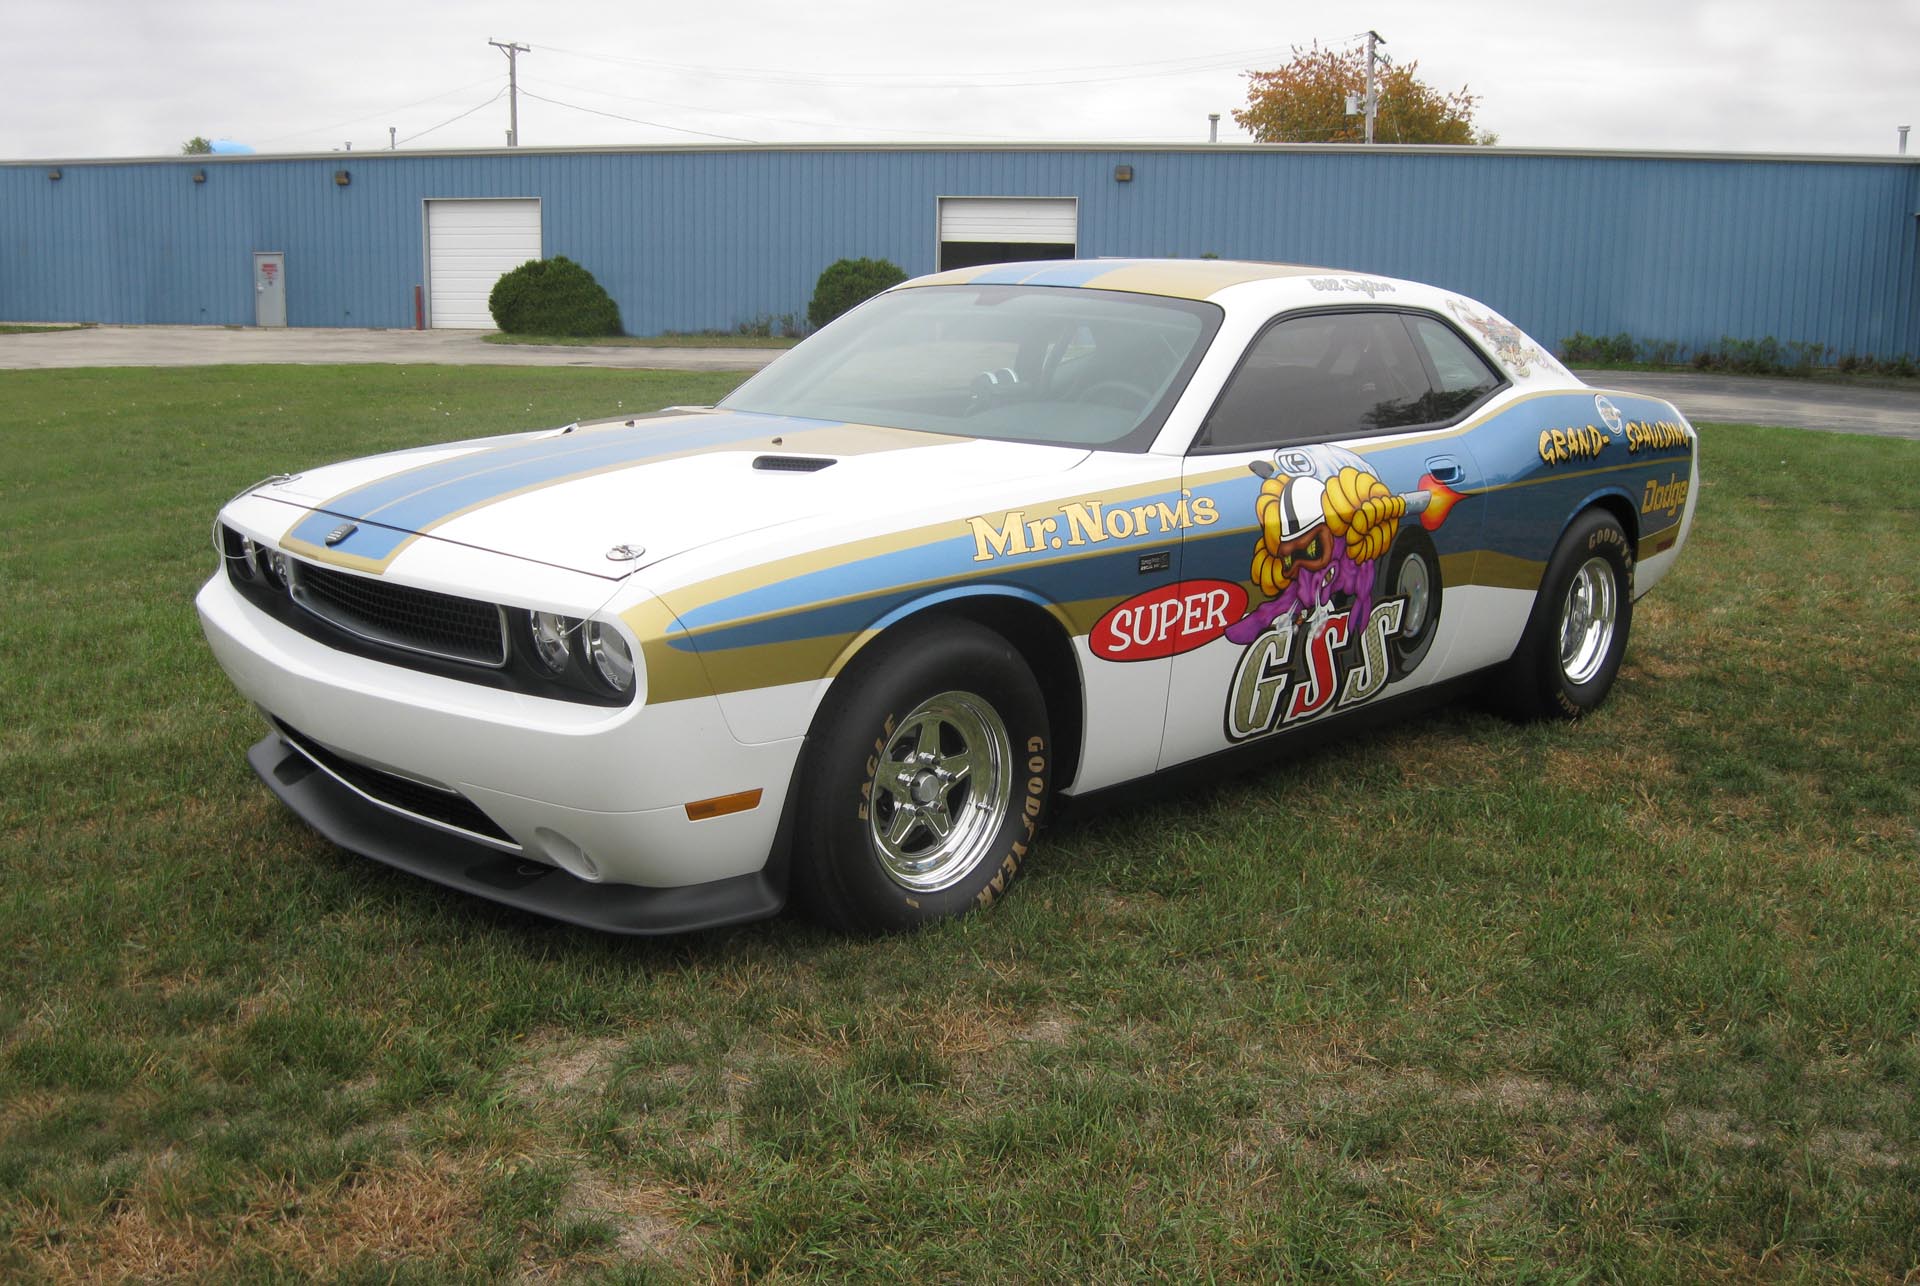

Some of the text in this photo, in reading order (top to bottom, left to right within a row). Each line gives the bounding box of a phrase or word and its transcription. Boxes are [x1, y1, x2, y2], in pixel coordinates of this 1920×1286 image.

[1640, 472, 1690, 517] Dodge
[1107, 587, 1231, 652] SUPER
[1227, 598, 1406, 740] GSS
